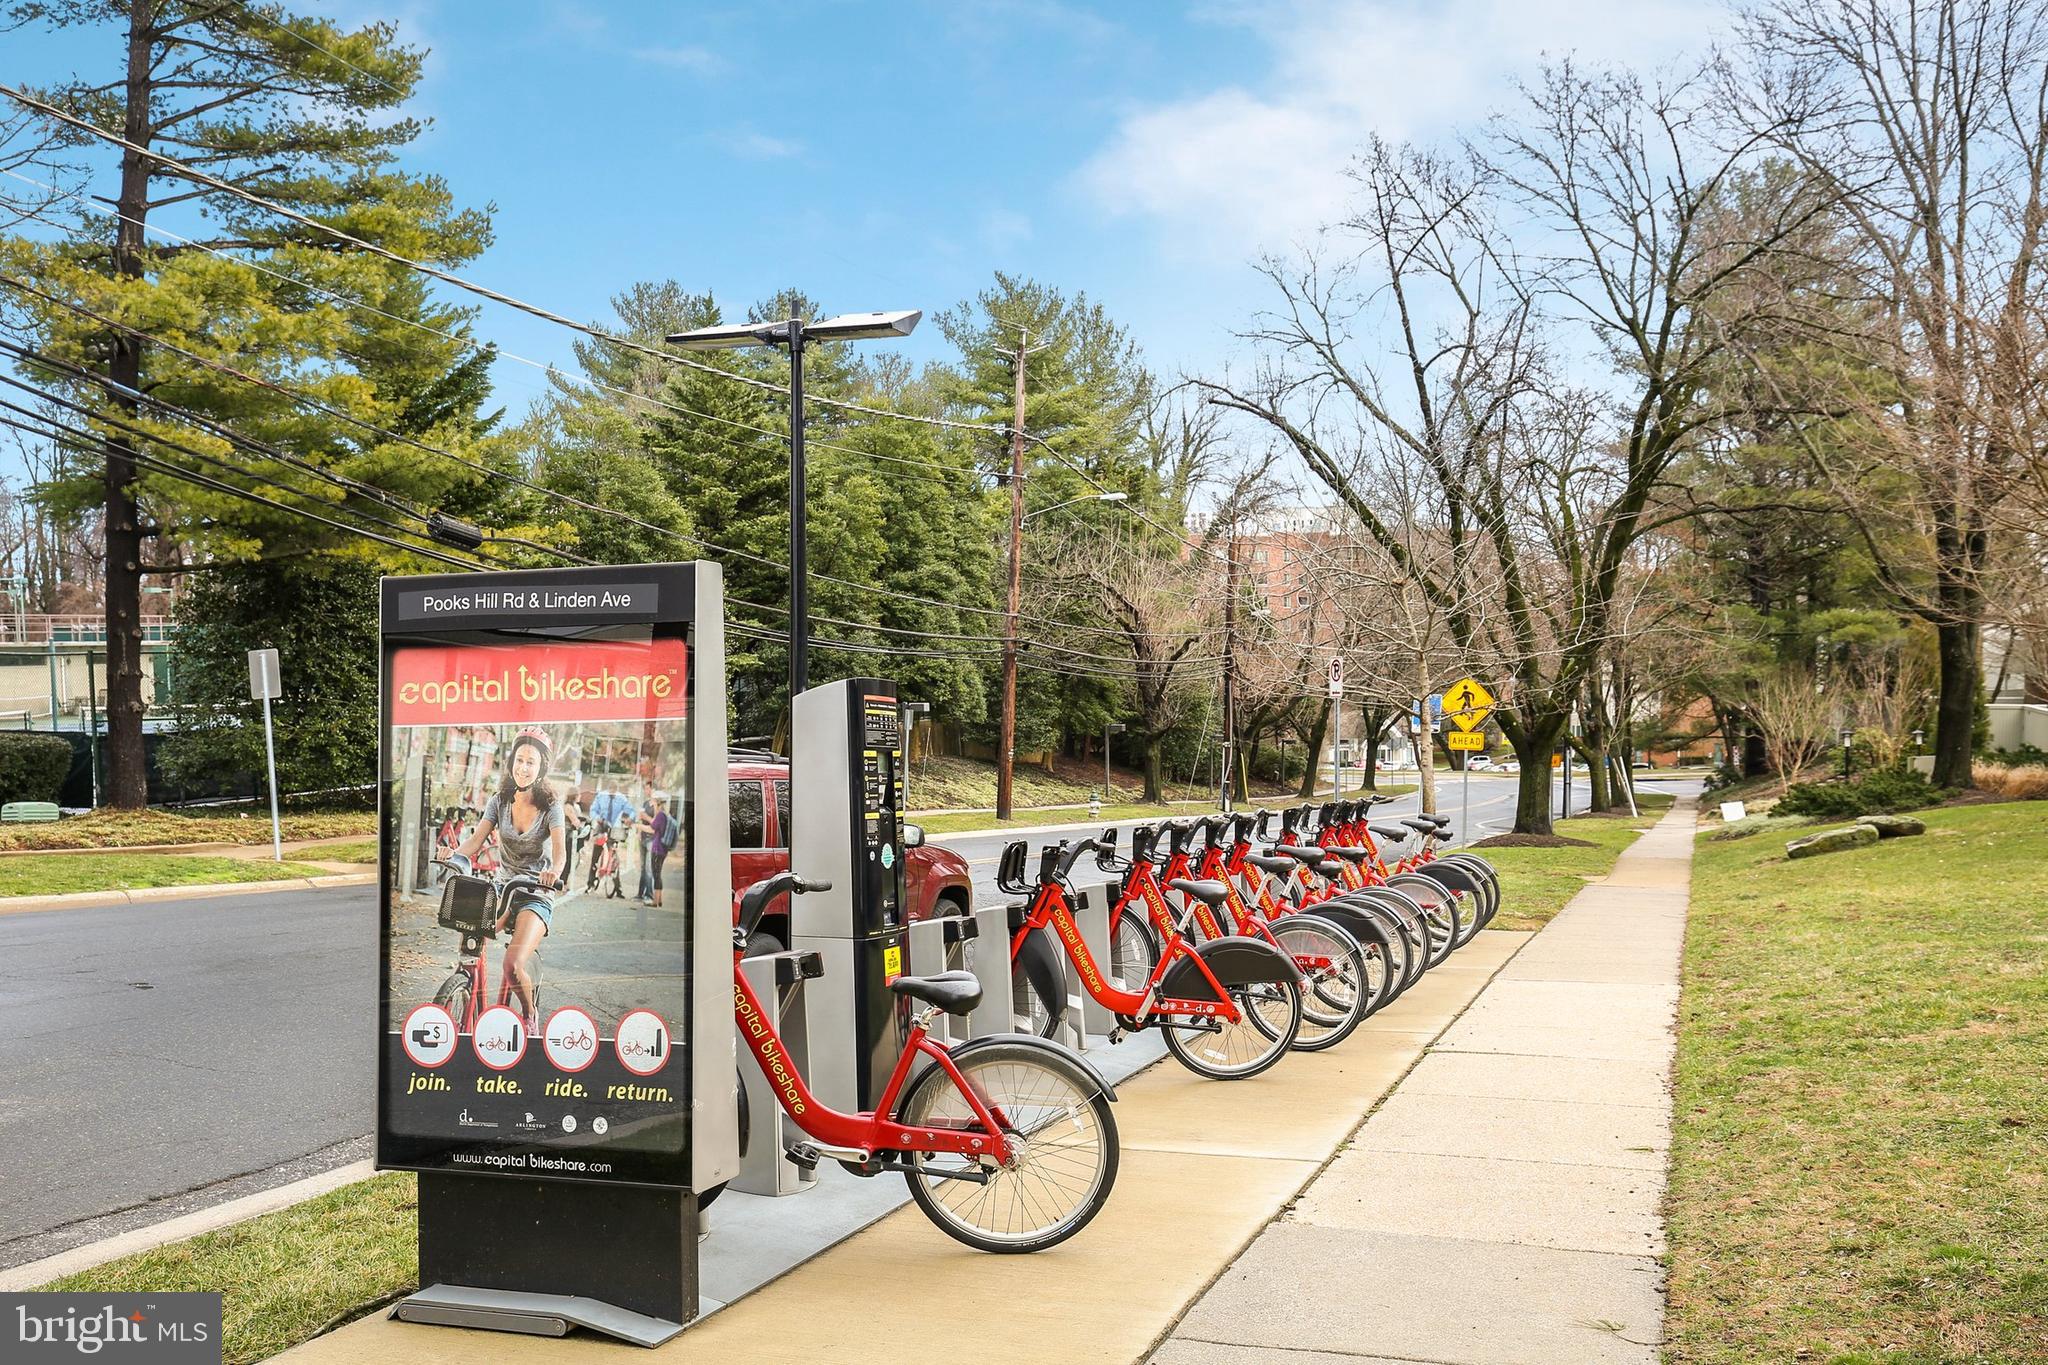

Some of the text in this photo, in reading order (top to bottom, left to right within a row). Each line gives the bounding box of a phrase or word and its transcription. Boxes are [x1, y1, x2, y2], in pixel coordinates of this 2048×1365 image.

[423, 591, 632, 612] Pooks Hill Rd & Linden Ave
[399, 670, 510, 712] capital
[517, 664, 672, 702] bikeshare
[1452, 736, 1481, 746] AHEAD
[1143, 882, 1166, 916] capital
[1196, 903, 1218, 939] bikesha
[1054, 908, 1102, 993] capital bikeshare
[406, 1072, 452, 1095] join.
[475, 1075, 523, 1096] take.
[760, 1037, 806, 1115] bikeshare
[544, 1078, 589, 1098] ride.
[606, 1084, 674, 1103] return.
